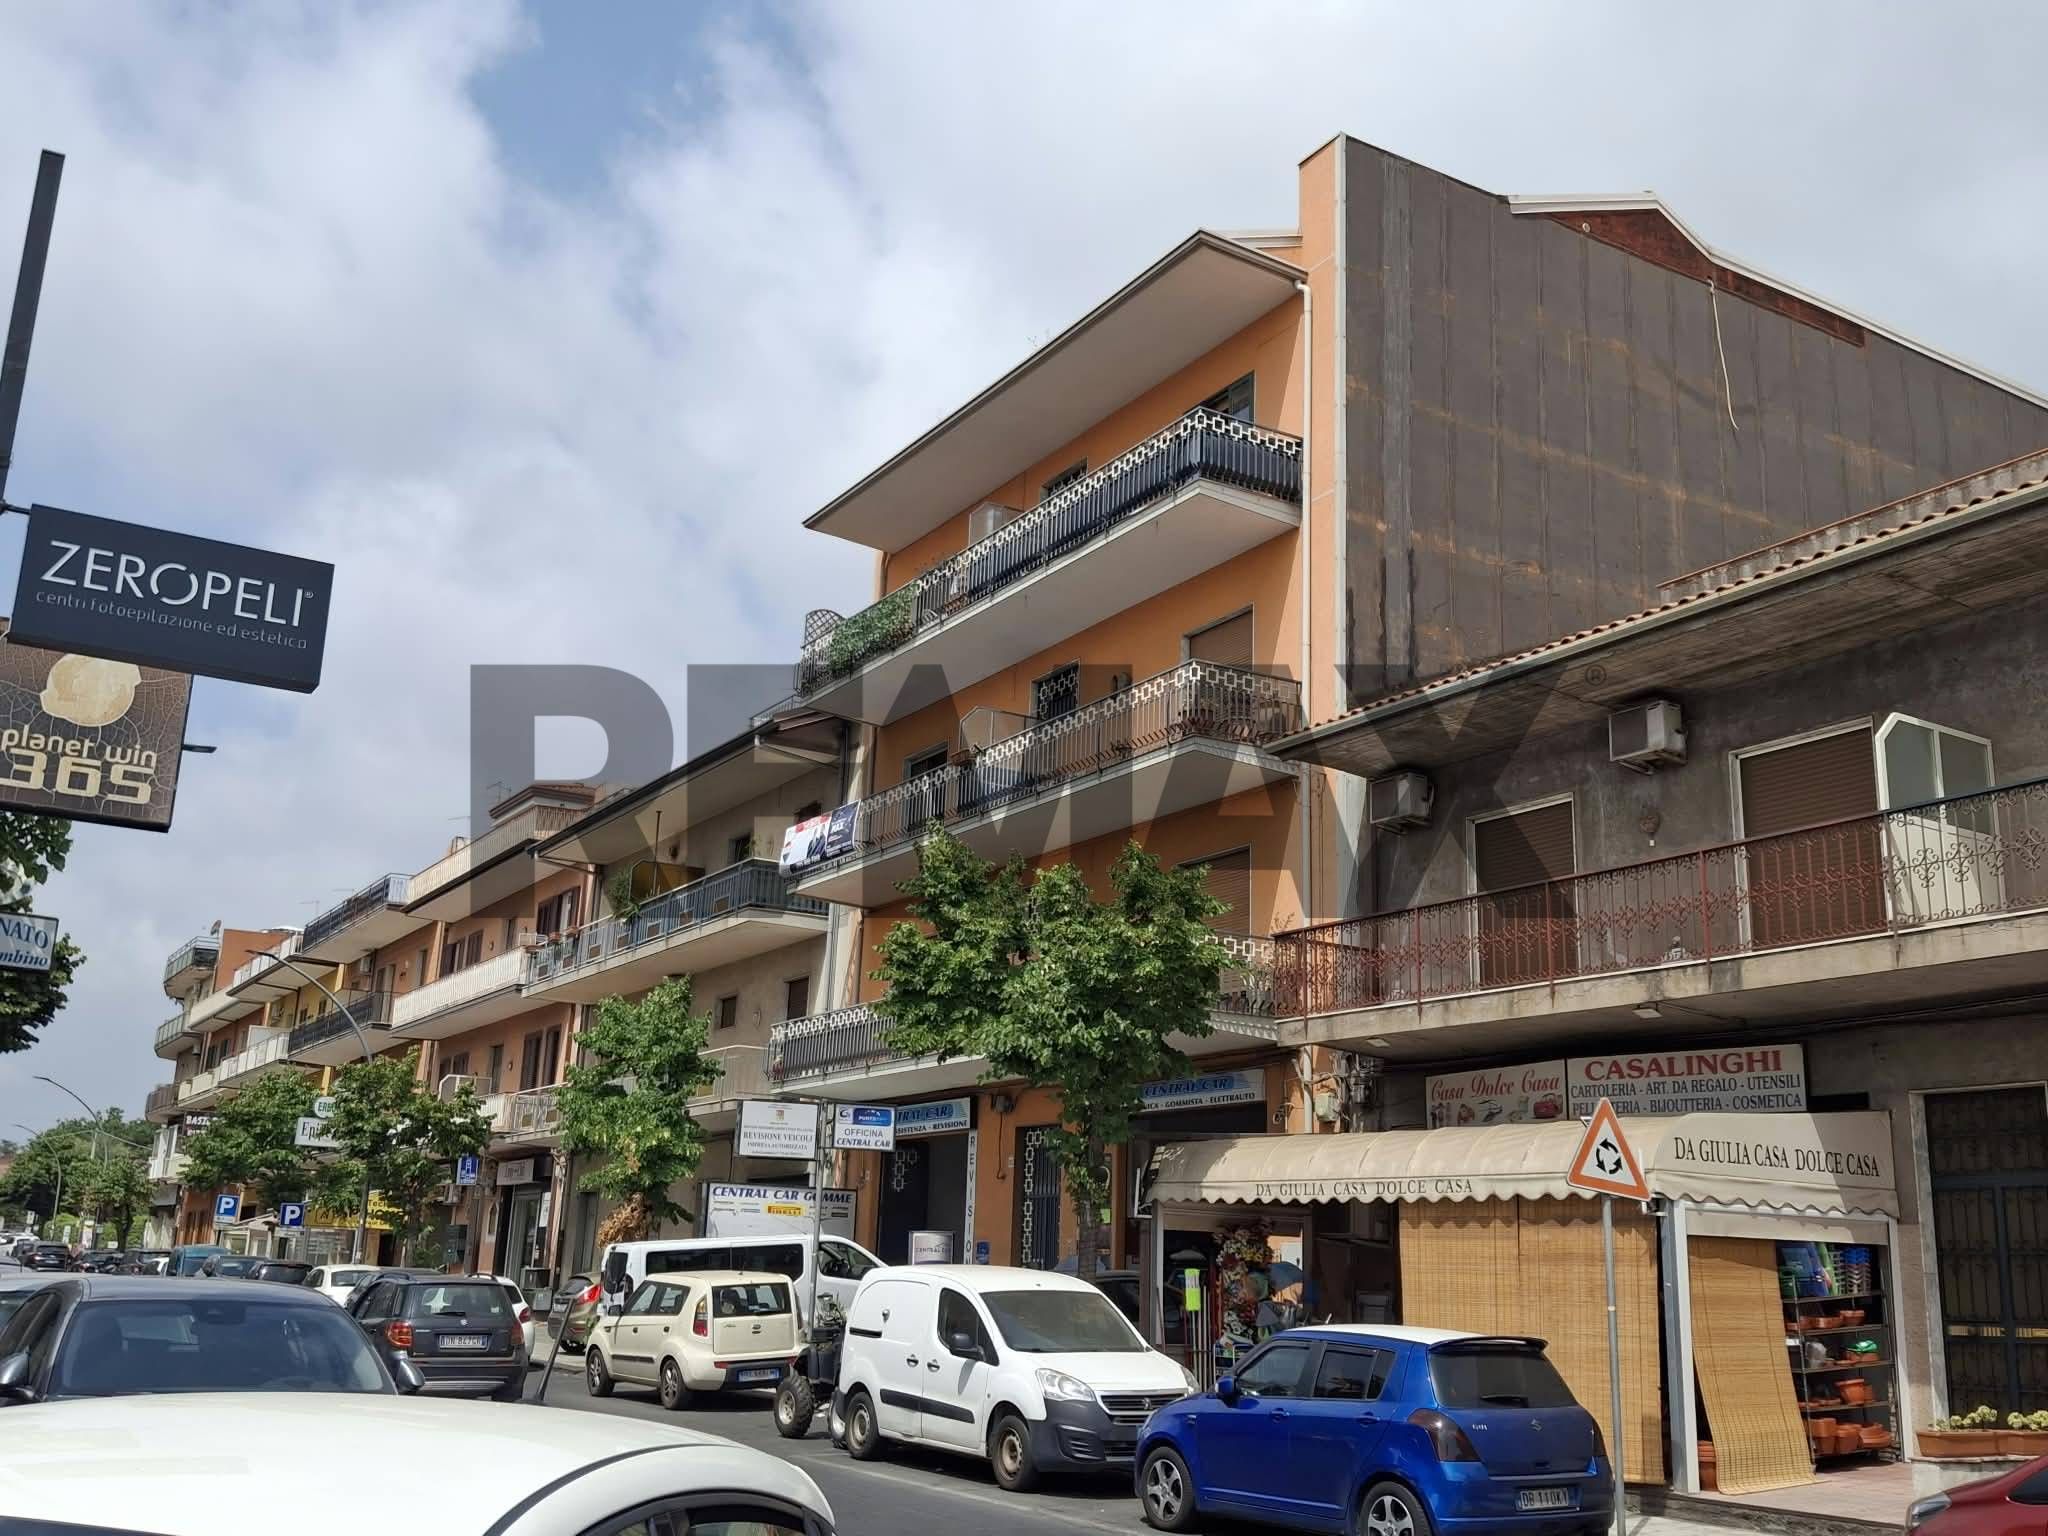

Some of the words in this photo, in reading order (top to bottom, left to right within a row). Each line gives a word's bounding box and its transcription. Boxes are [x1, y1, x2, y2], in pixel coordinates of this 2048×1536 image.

[36, 591, 86, 609] centri
[216, 623, 236, 637] ed
[241, 629, 307, 649] estetica
[2, 724, 96, 757] planet
[105, 745, 158, 770] win
[0, 748, 154, 804] 365
[1584, 1050, 1783, 1082] CASALINGHI
[1431, 1079, 1465, 1101] Casa
[1471, 1072, 1514, 1098] Dolce
[1521, 1069, 1560, 1093] Casa
[1570, 1082, 1636, 1098] CARTOLERIA
[1647, 1080, 1667, 1096] ART.
[1672, 1080, 1689, 1095] DA
[1691, 1077, 1737, 1094] REGALO
[1747, 1074, 1801, 1091] UTENSILI
[1210, 1092, 1255, 1103] ELETTRAUTO
[1650, 1096, 1722, 1113] BIJOUTTERIA
[1732, 1093, 1802, 1111] COSMETICA
[743, 1131, 782, 1142] REVISIONE
[844, 1128, 883, 1137] OFFICINA
[837, 1137, 871, 1147] CENTRAL
[875, 1139, 891, 1148] CAR
[1674, 1137, 1696, 1161] DA
[1699, 1139, 1751, 1165] GIULIA
[1754, 1144, 1790, 1168] CASA
[1795, 1149, 1844, 1174] DOLCE
[1847, 1153, 1880, 1177] CASA
[713, 1186, 768, 1199] CENTRAL
[774, 1189, 799, 1200] CAR
[1256, 1183, 1272, 1196] DA
[1280, 1183, 1325, 1196] GIULIA
[1334, 1182, 1367, 1195] CASA
[1376, 1180, 1426, 1195] DOLCE
[1435, 1179, 1473, 1194] CASA
[219, 1198, 235, 1214] P
[285, 1206, 300, 1225] P
